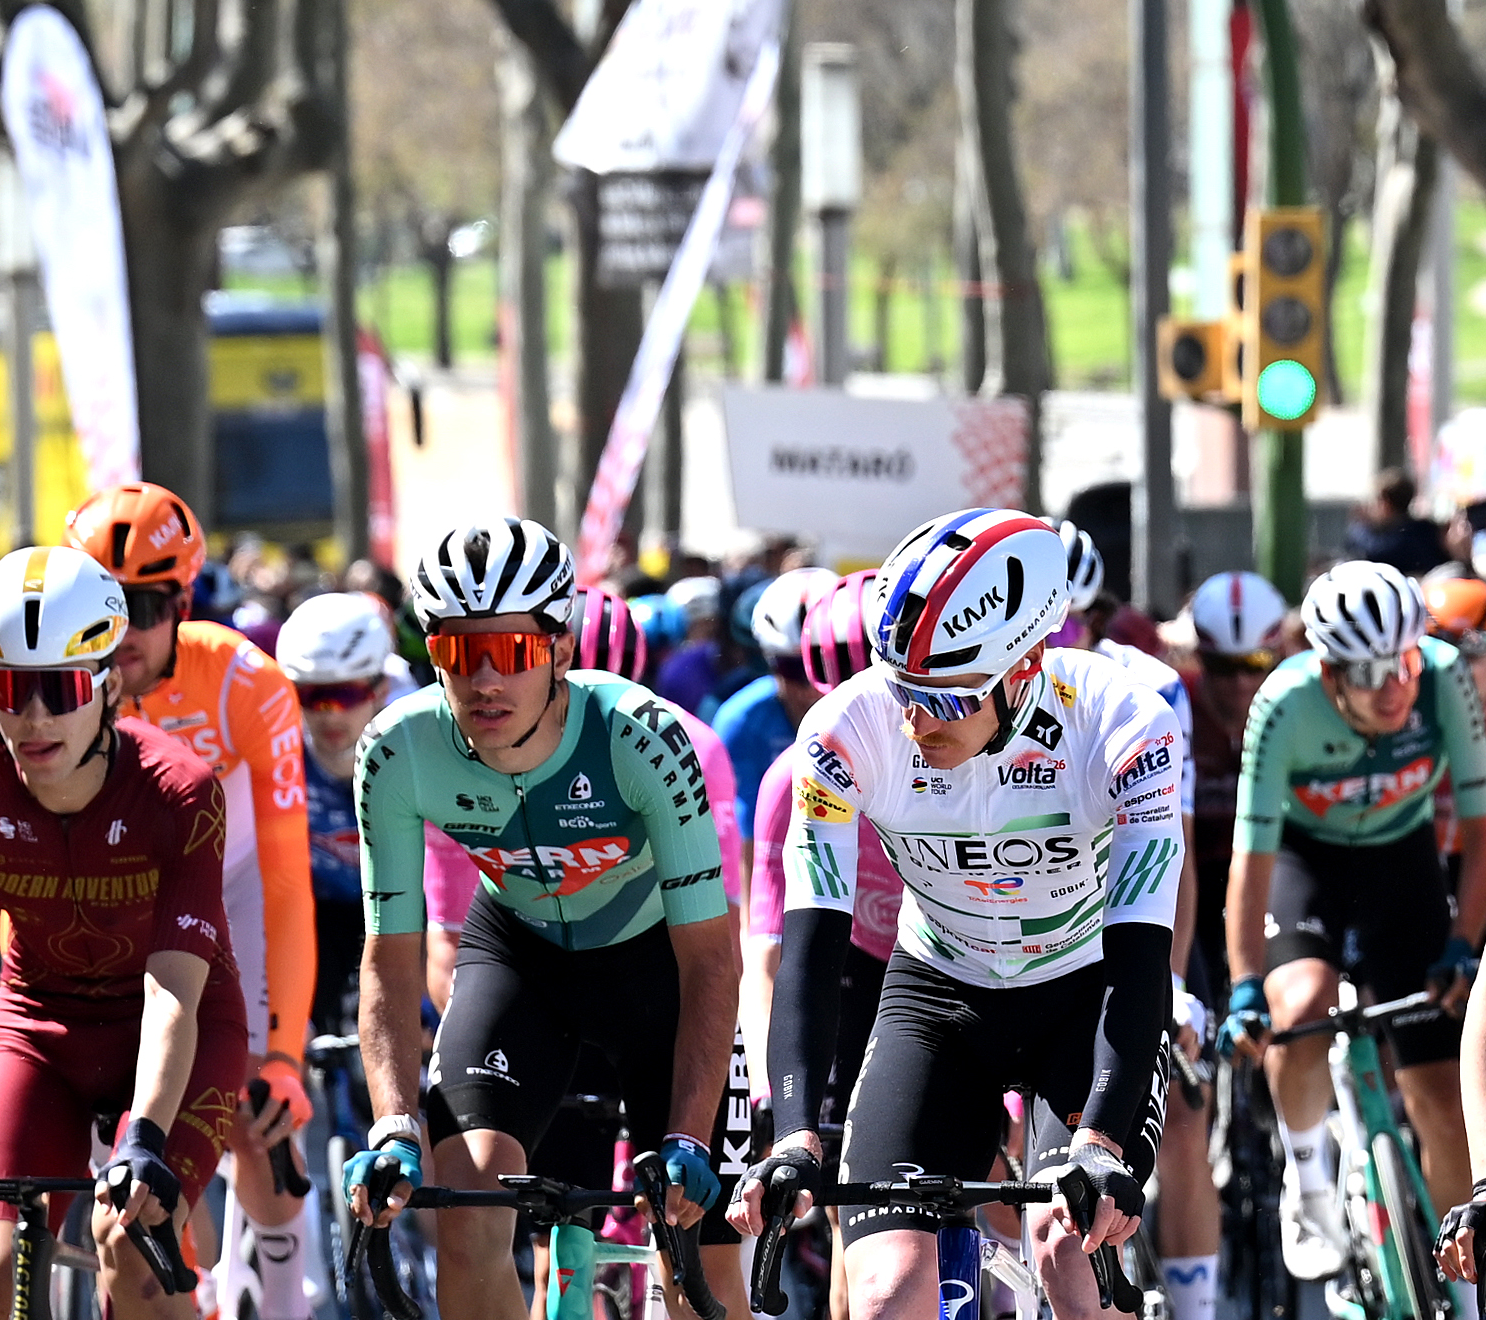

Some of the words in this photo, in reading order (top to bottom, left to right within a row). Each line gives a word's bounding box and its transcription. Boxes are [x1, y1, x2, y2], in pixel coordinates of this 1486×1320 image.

[942, 586, 1004, 639] KASK
[1006, 588, 1057, 652] GRENADIER
[260, 687, 303, 809] INEOS
[633, 699, 709, 817] KERN
[620, 724, 692, 827] PHARMA
[997, 762, 1056, 787] Volta
[1109, 744, 1171, 799] Volta
[555, 800, 604, 811] ETXEONDO
[1123, 783, 1175, 809] esportcat
[444, 822, 502, 834] GIANT
[463, 842, 626, 868] KERN
[900, 835, 1080, 871] INEOS
[64, 868, 159, 900] ADVENTUR
[1050, 879, 1085, 899] GOBIK
[783, 1074, 794, 1100] GOBIK
[1097, 1069, 1111, 1093] GOBIK
[848, 1204, 942, 1227] GRENADIE
